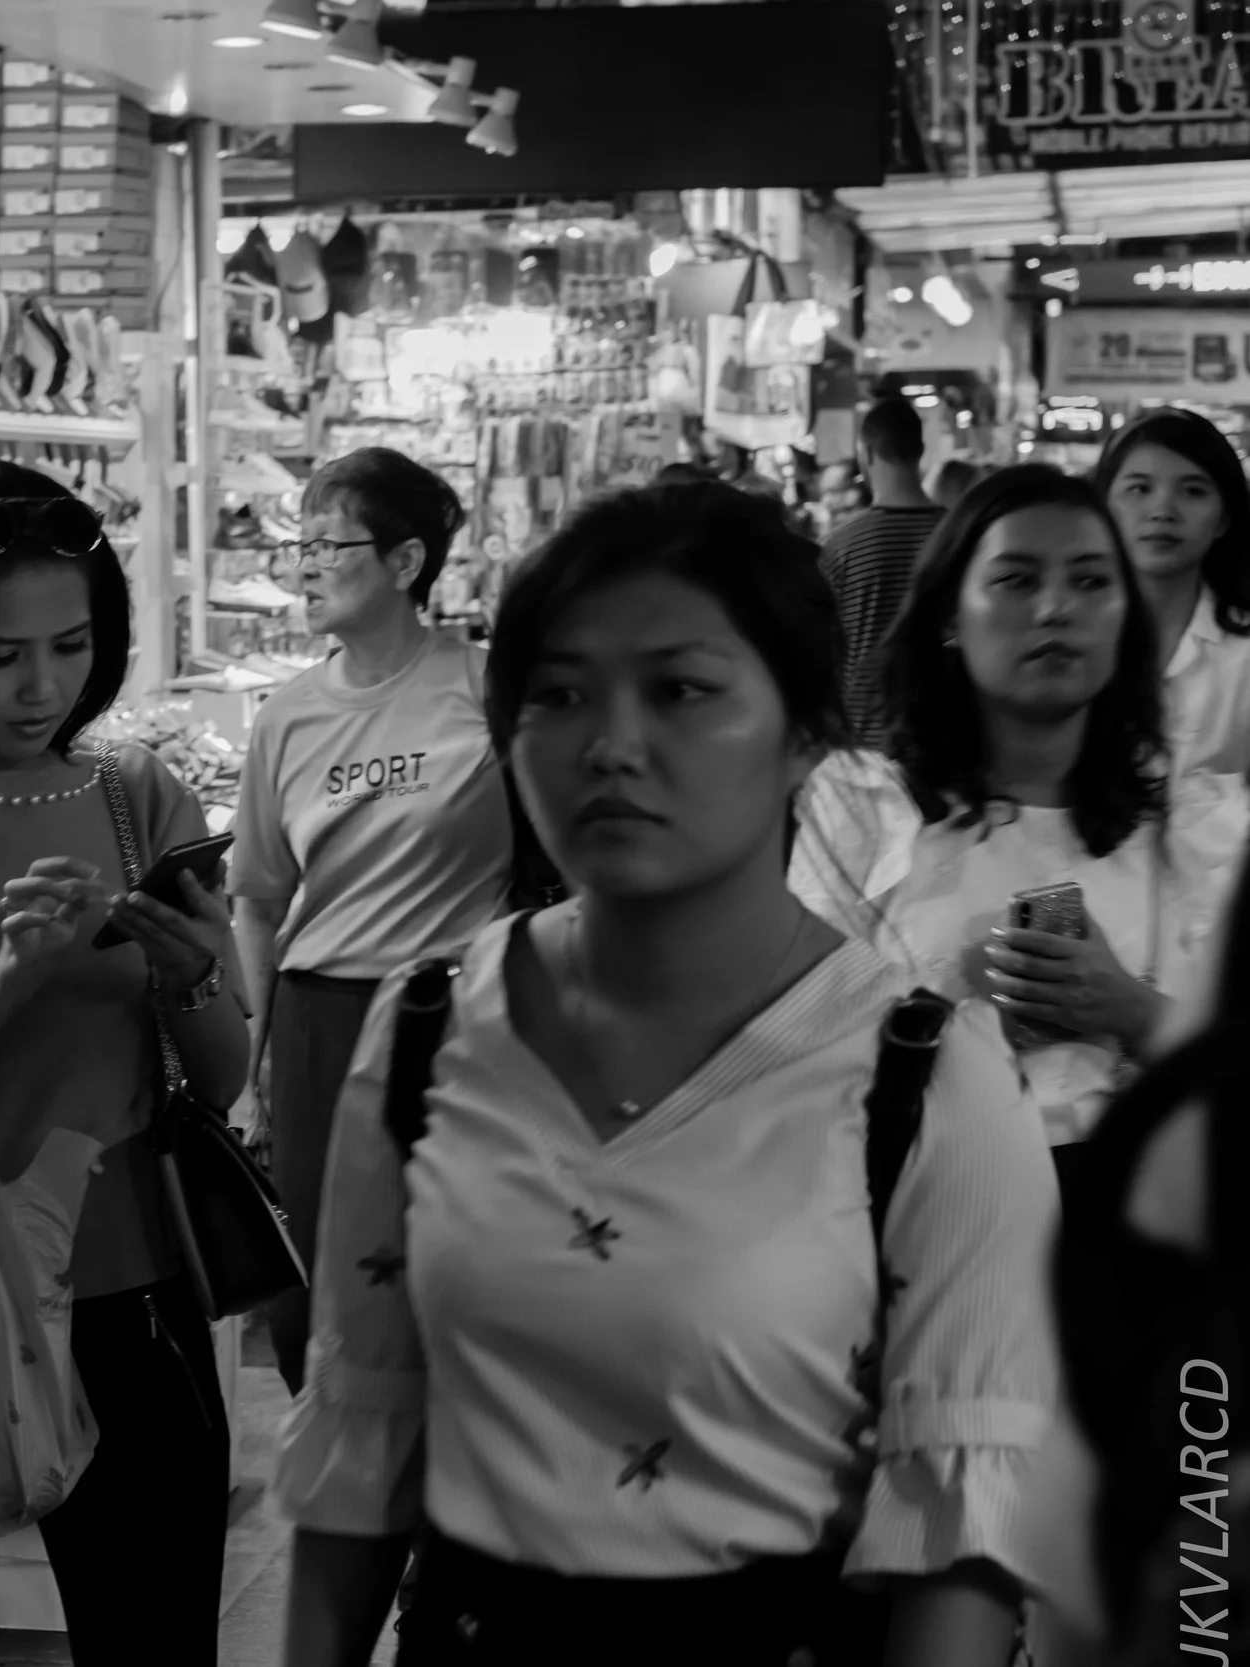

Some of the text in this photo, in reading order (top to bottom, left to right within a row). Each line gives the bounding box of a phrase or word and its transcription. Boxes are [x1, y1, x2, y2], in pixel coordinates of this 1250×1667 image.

[1029, 127, 1102, 154] MOBILE
[1107, 124, 1173, 151] PHONE
[327, 752, 426, 794] SPORT
[388, 783, 430, 797] TOUR
